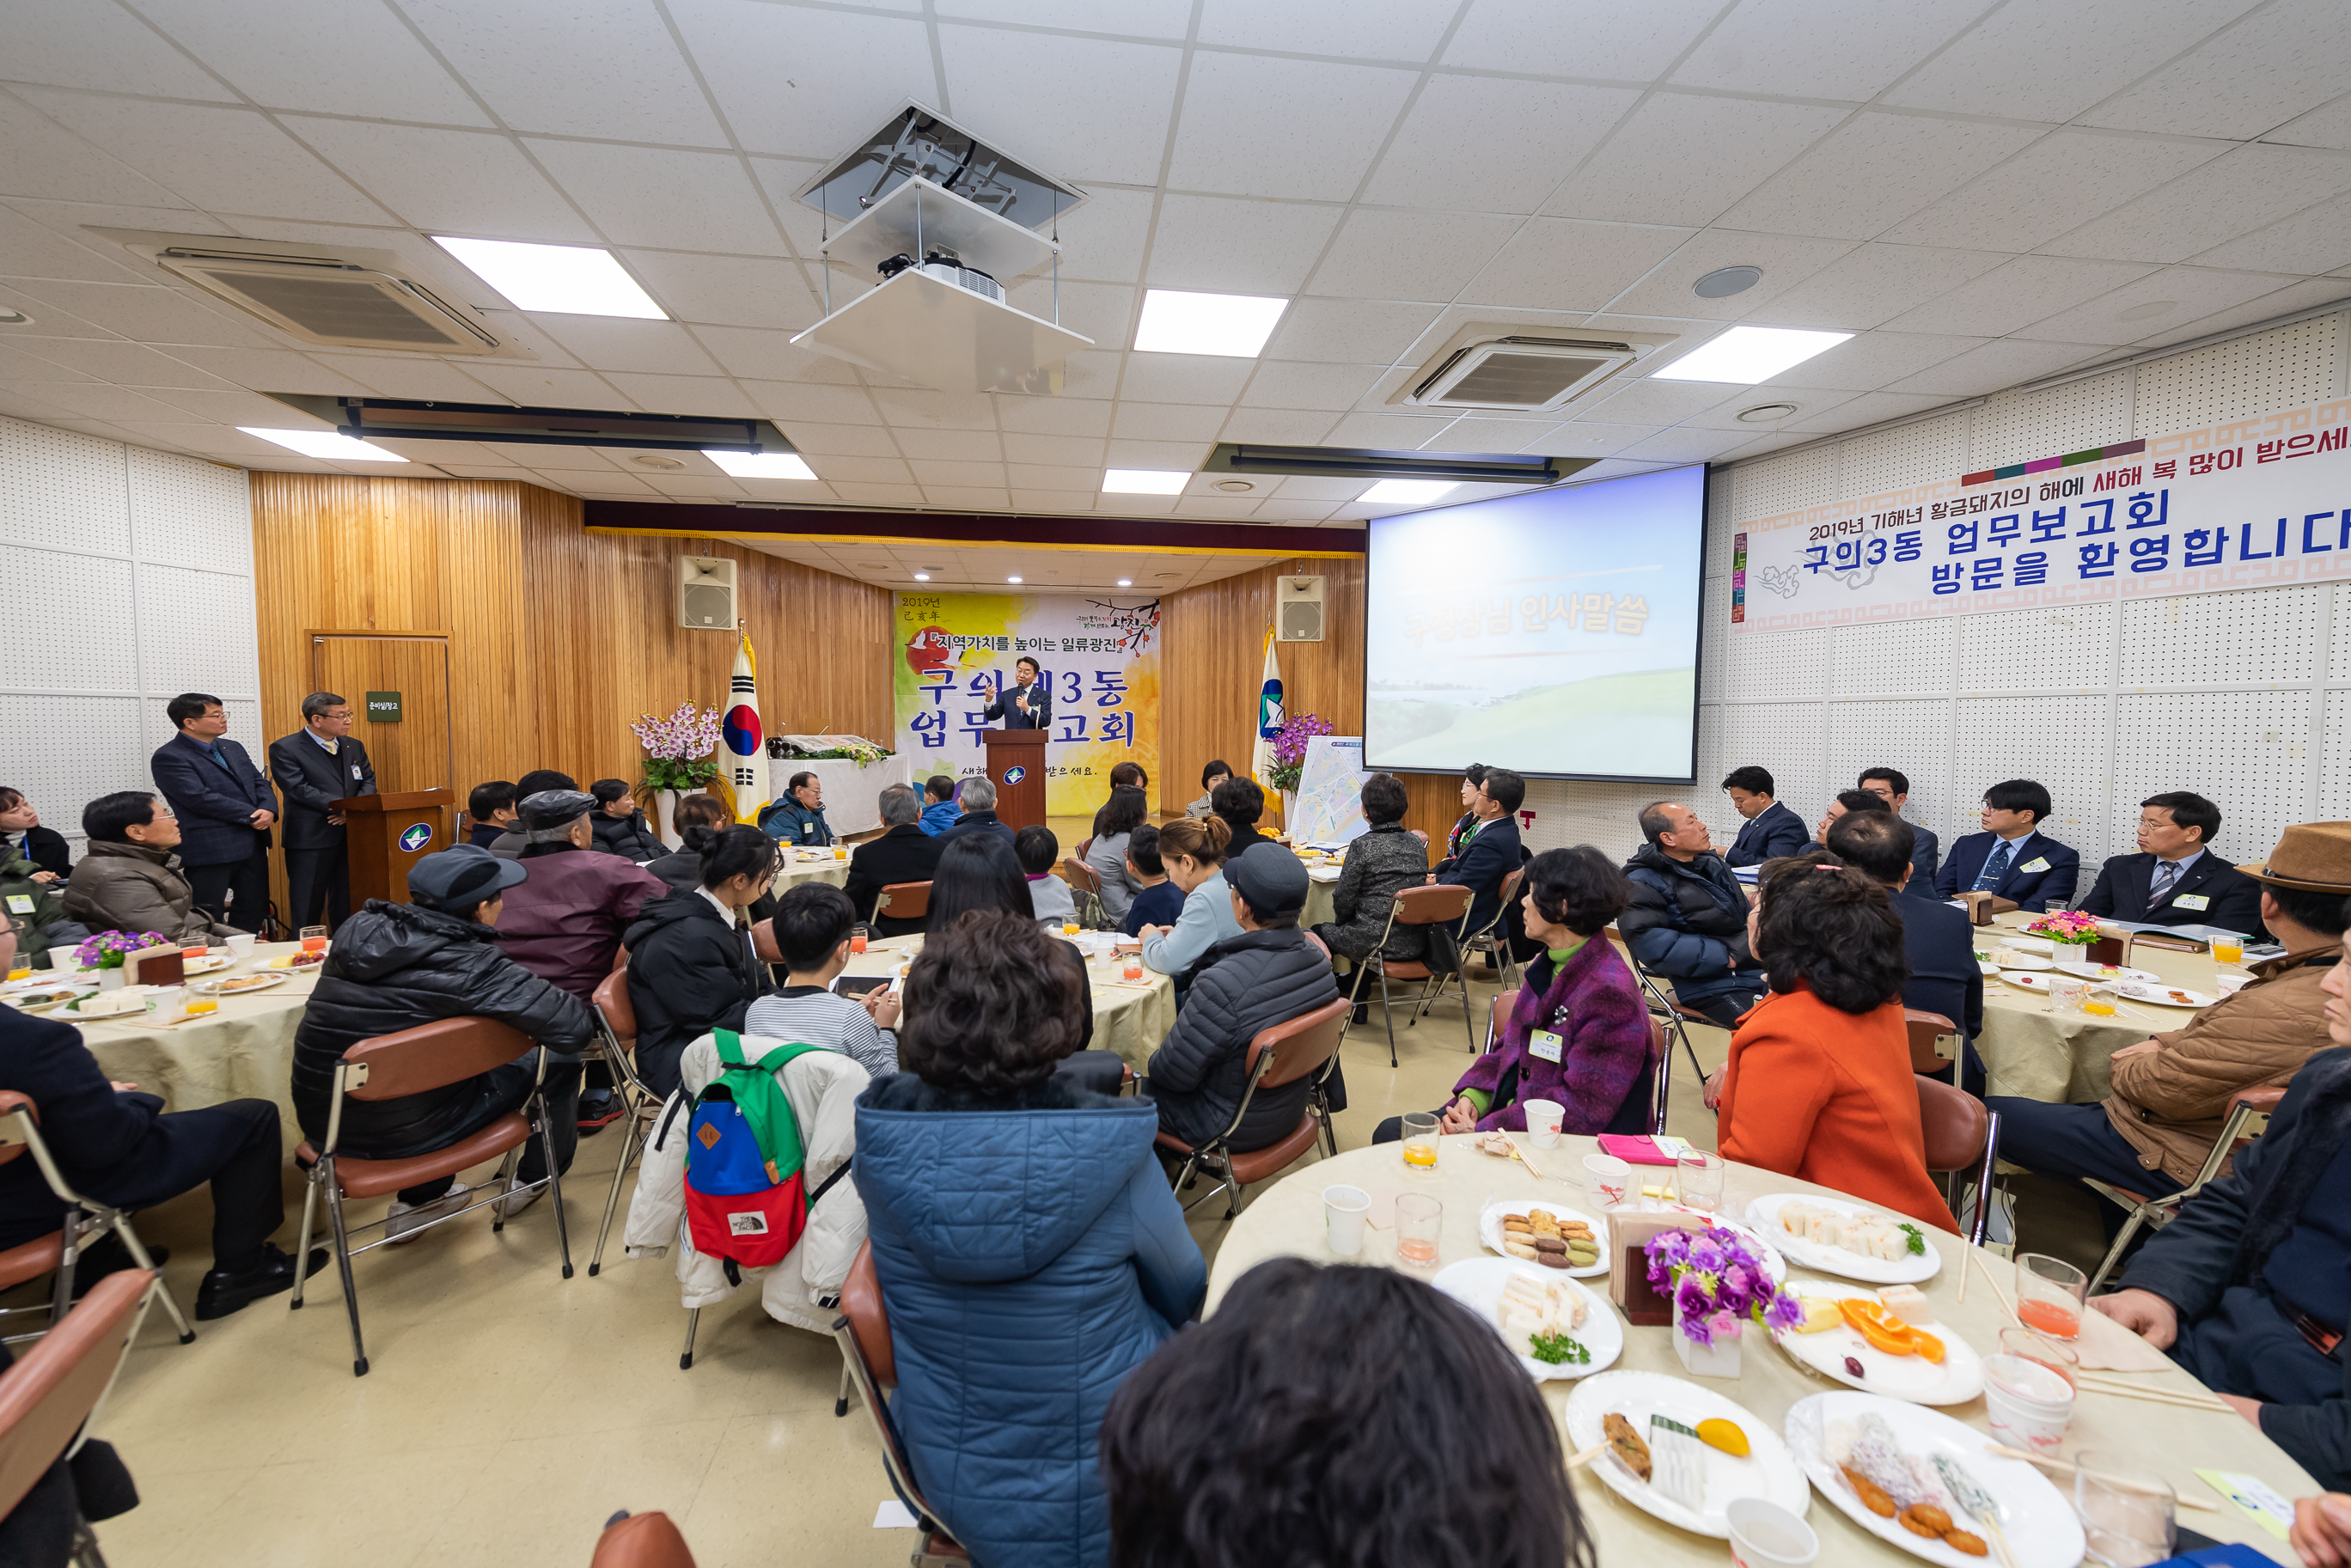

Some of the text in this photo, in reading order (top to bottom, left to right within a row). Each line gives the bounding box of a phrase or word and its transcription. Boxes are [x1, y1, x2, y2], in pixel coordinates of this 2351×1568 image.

[1809, 426, 2351, 541] 2019년 기해년 황금돼지의 해에 새해 복 많이 받으세
[1804, 488, 2169, 574] 구의3동 업무보고회
[1932, 509, 2351, 595] 방문을 환영합니다
[902, 597, 941, 608] 2019년
[904, 610, 941, 622] 己亥年
[1405, 592, 1649, 647] 구청장님 인사말씀
[1015, 637, 1057, 652] 높이는
[910, 710, 1134, 748] 업무고회
